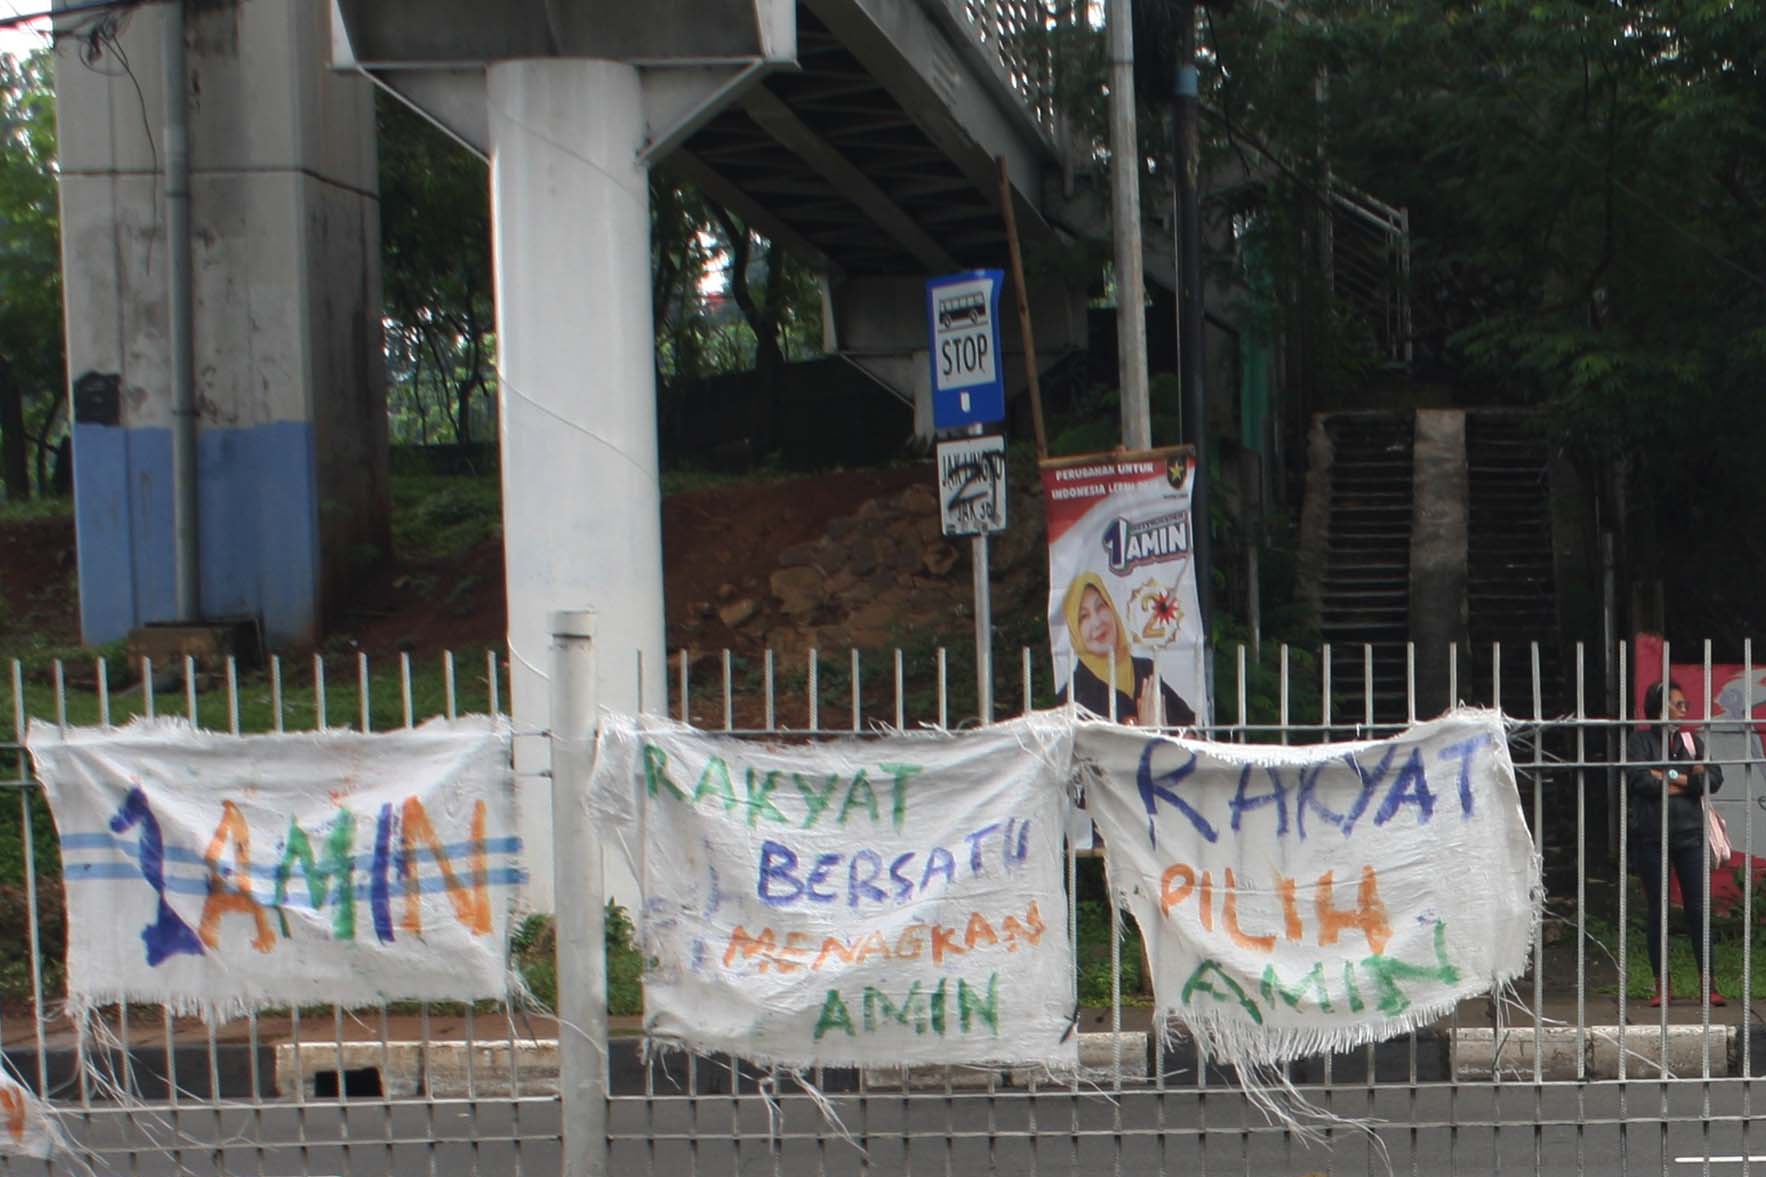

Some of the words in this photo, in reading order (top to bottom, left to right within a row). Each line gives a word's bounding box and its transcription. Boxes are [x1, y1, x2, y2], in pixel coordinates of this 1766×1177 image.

[942, 333, 988, 377] STOP
[1051, 484, 1106, 501] INDONESIA
[1055, 464, 1116, 482] PERUBAHAN
[1117, 462, 1154, 475] UNTUK
[1126, 522, 1187, 560] AMIN
[643, 743, 922, 829] RAKYAT
[1136, 733, 1493, 850] RAKYAT
[200, 796, 492, 953] AMIN
[757, 818, 1032, 908] BERSATU
[1160, 862, 1393, 955] PILIH
[813, 972, 999, 1040] AMIN
[1181, 919, 1460, 1024] AMIN
